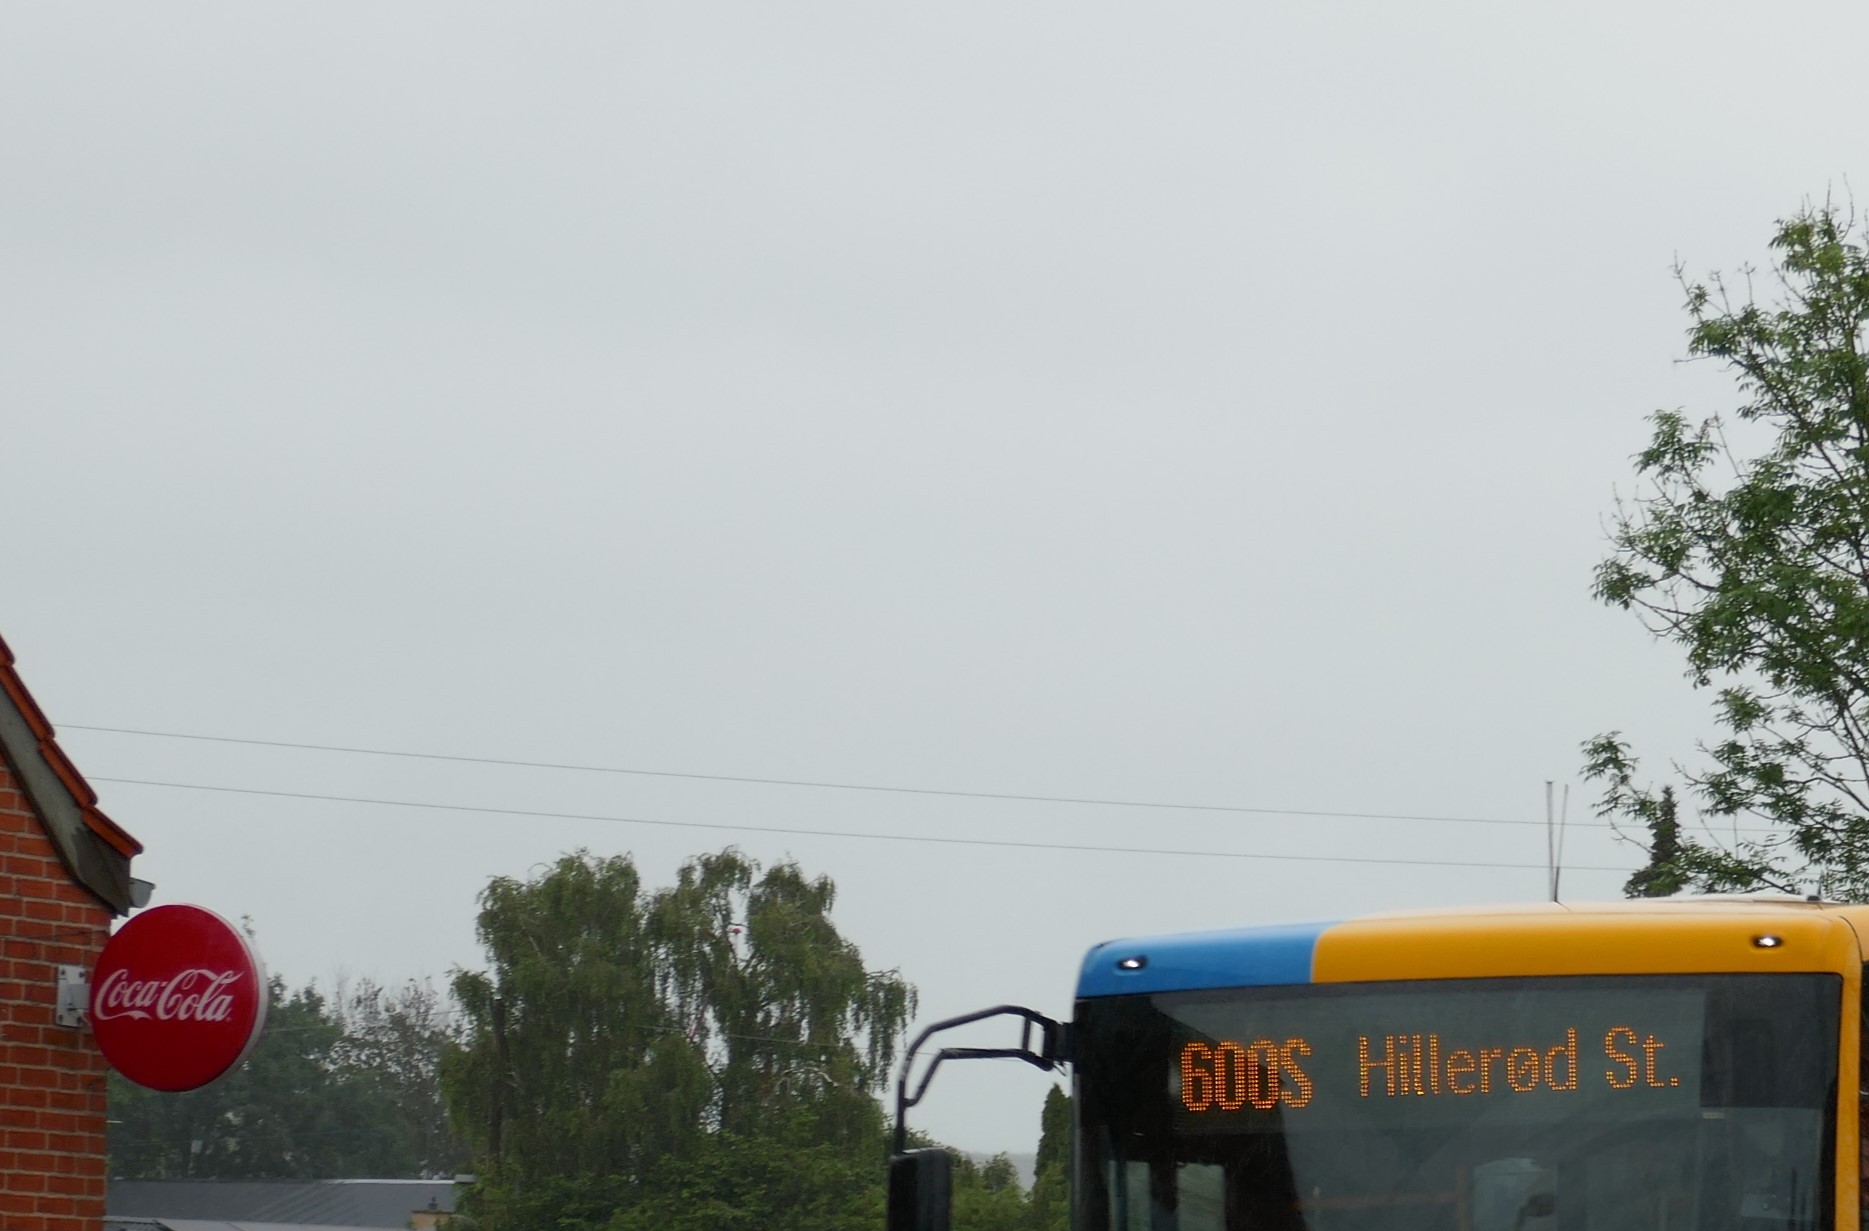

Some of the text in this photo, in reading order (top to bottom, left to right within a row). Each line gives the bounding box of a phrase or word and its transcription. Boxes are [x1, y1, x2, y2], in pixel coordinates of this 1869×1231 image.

[94, 968, 243, 1022] Coca-Cola
[1180, 1027, 1679, 1113] 600S Hillerød St.
